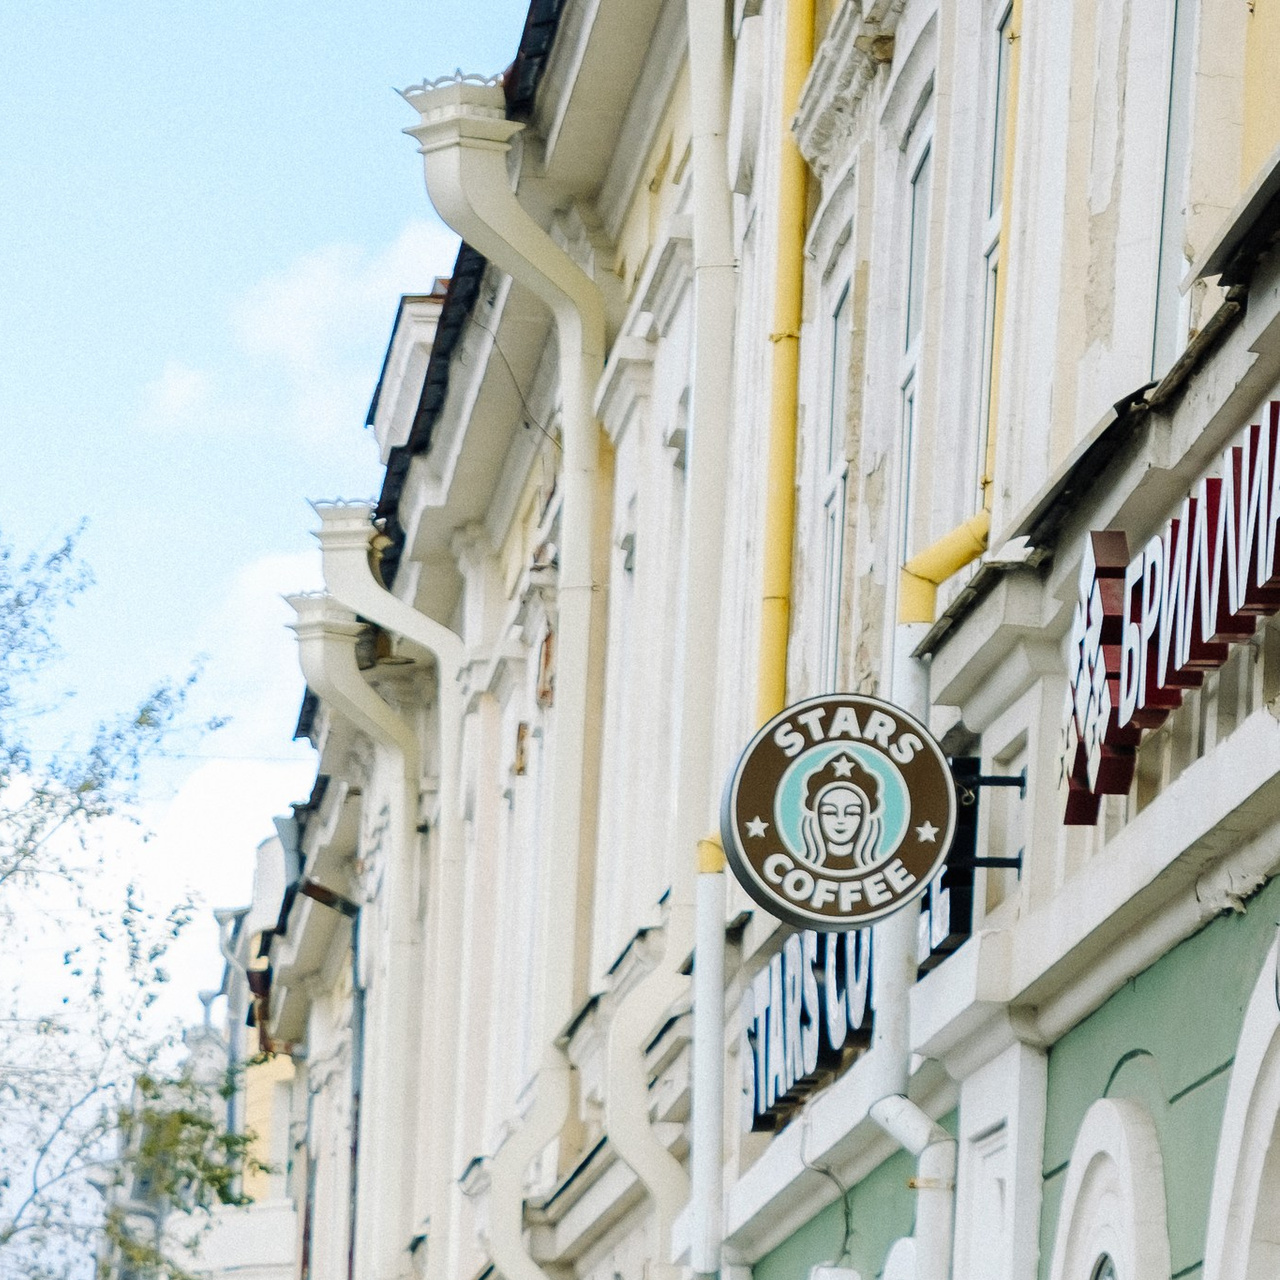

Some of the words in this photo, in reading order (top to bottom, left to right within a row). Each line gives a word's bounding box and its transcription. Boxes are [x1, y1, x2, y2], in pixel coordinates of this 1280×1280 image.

[773, 706, 924, 765] STARS
[762, 852, 917, 912] COFFEE
[742, 928, 820, 1133] STARS
